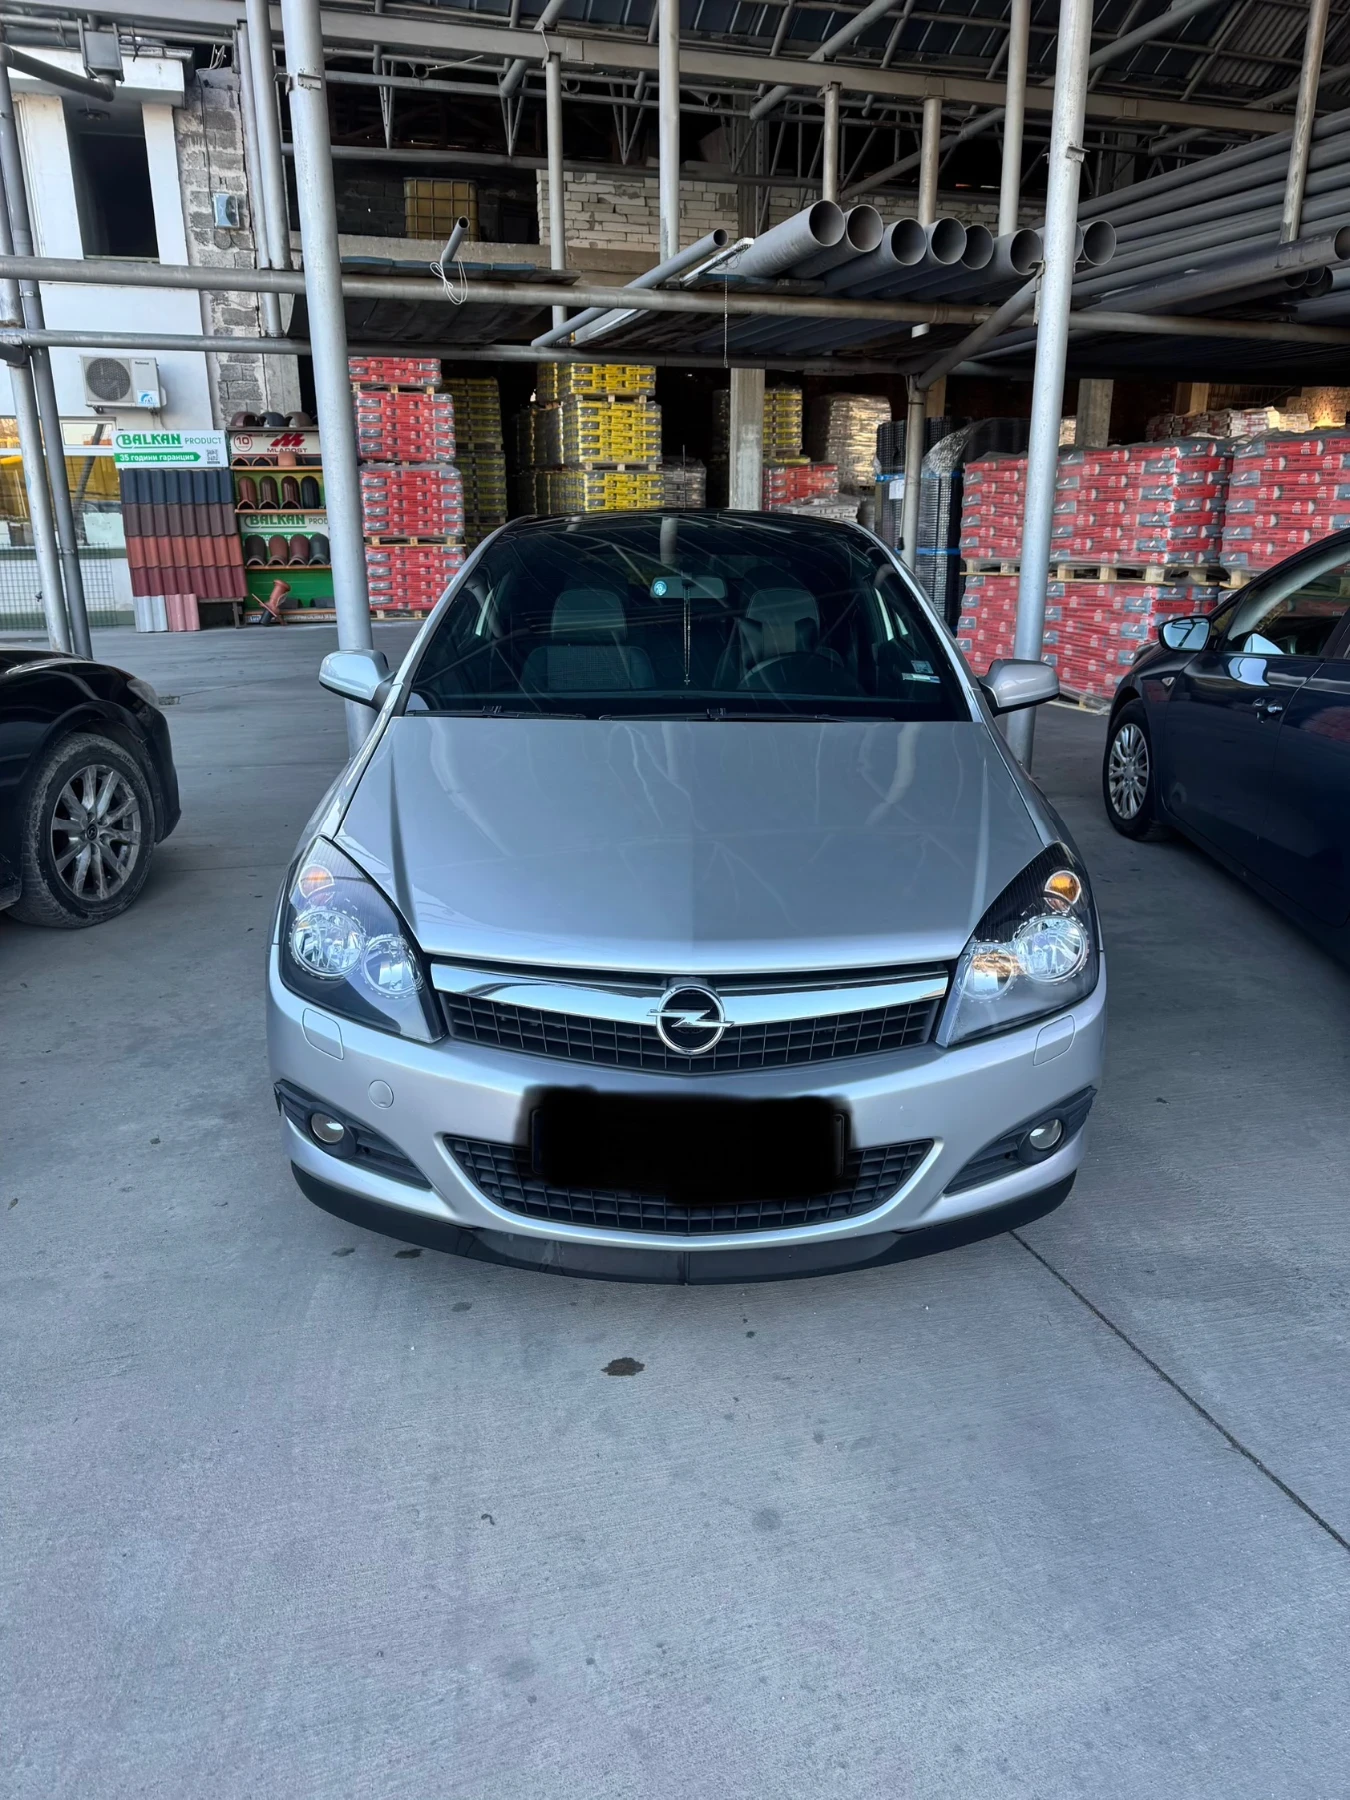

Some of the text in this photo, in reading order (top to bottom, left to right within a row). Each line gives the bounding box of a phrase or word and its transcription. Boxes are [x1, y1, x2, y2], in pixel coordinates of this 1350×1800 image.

[120, 433, 222, 445] BALKAN PRODUCT
[236, 436, 250, 445] 10
[119, 453, 195, 462] 35 години гаранция
[249, 515, 306, 525] BALKAN
